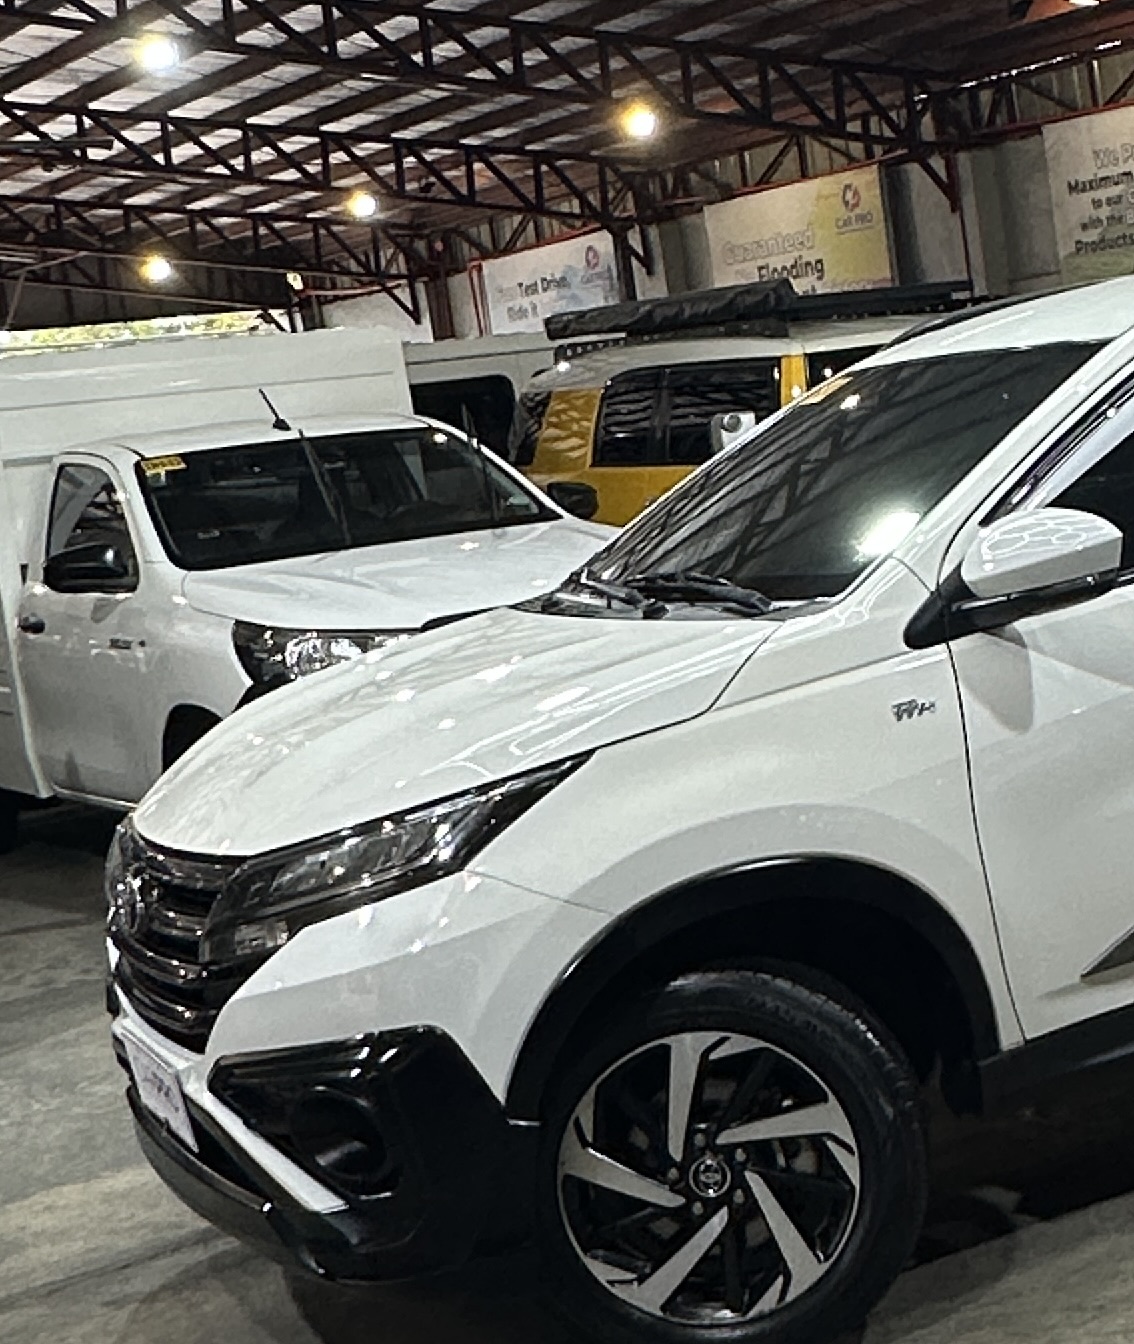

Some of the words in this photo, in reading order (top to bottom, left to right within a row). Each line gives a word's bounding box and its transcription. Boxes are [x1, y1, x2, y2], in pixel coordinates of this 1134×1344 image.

[1067, 170, 1134, 196] Maximum
[722, 223, 816, 266] Guaranteed
[756, 255, 825, 281] Flooding
